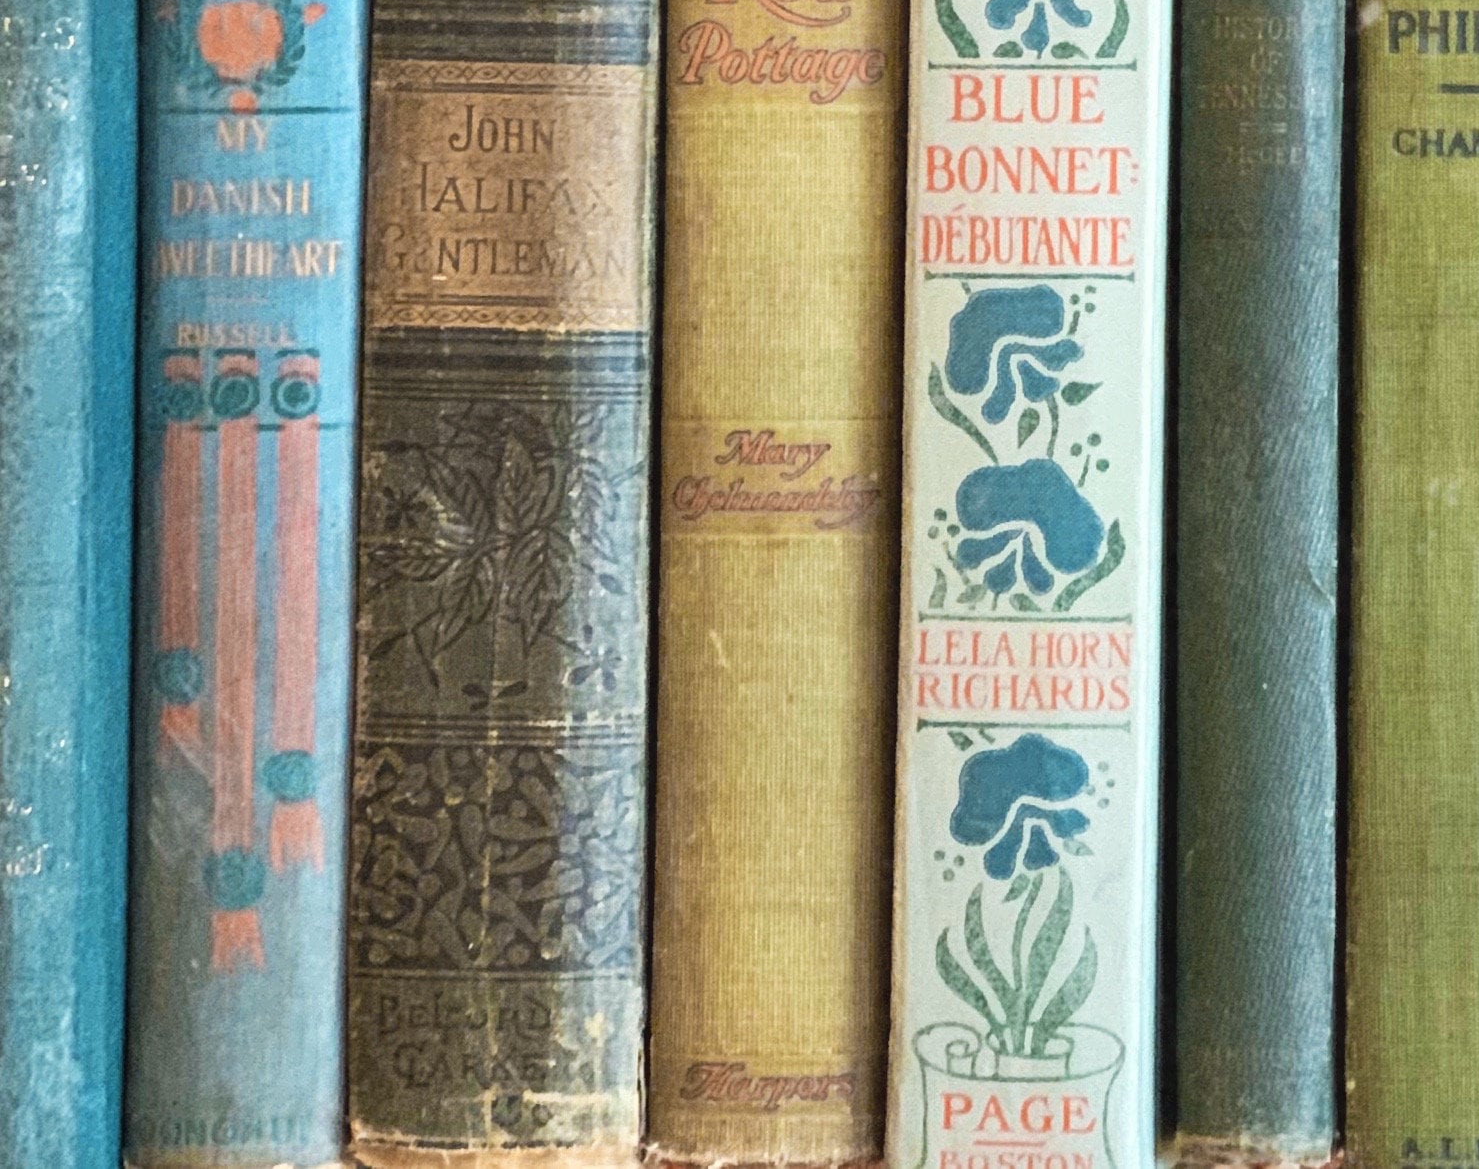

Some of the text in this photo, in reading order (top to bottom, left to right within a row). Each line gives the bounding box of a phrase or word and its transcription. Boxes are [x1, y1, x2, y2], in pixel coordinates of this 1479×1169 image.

[675, 18, 887, 105] Pottage
[948, 73, 1105, 124] BLUE
[217, 118, 271, 153] MY
[448, 103, 557, 155] JOHN
[925, 144, 1139, 195] BONNET:
[170, 178, 313, 216] DANISH
[920, 203, 1135, 267] DÉBUTANTE
[153, 240, 343, 278] WEETHEART
[714, 428, 832, 481] Mary
[917, 629, 1134, 669] LELA HORN
[917, 671, 1131, 712] RICHARDS
[940, 1091, 1097, 1134] PAGE
